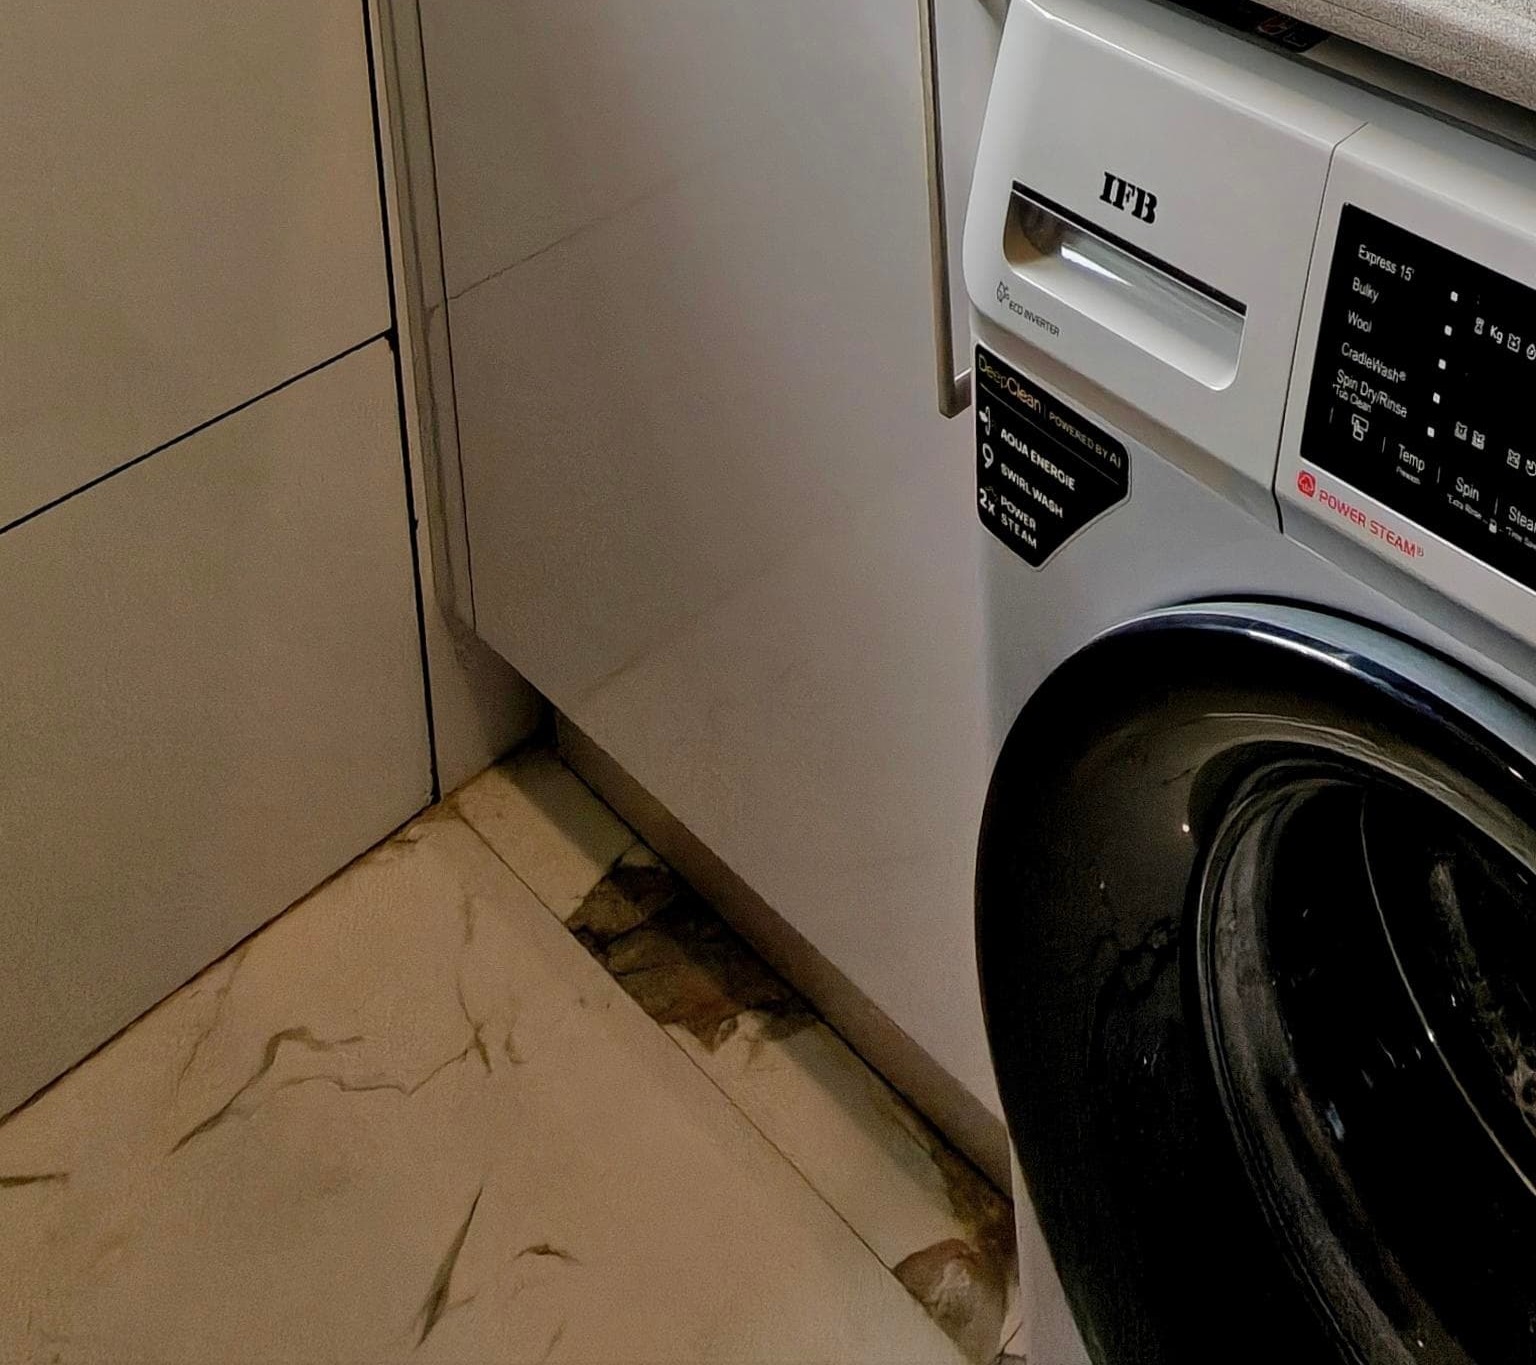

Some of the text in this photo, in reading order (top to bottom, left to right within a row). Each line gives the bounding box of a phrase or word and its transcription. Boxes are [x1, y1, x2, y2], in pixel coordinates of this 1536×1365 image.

[1099, 171, 1158, 224] IFB
[1358, 244, 1397, 274] Express
[1352, 276, 1379, 304] Bulky
[1347, 309, 1372, 333] Wool
[1490, 325, 1503, 344] Kg
[978, 354, 1041, 414] DeepClean
[1336, 369, 1358, 391] Spin
[1000, 428, 1030, 458] AQUA
[1049, 411, 1095, 450] POWERED
[1095, 443, 1109, 460] BY
[1398, 443, 1425, 473] Temp
[1000, 463, 1032, 496] SWIRL
[1455, 477, 1480, 502] Spin
[1000, 494, 1037, 532] POWER
[1319, 489, 1367, 528] POWER
[1000, 513, 1037, 550] STEAM
